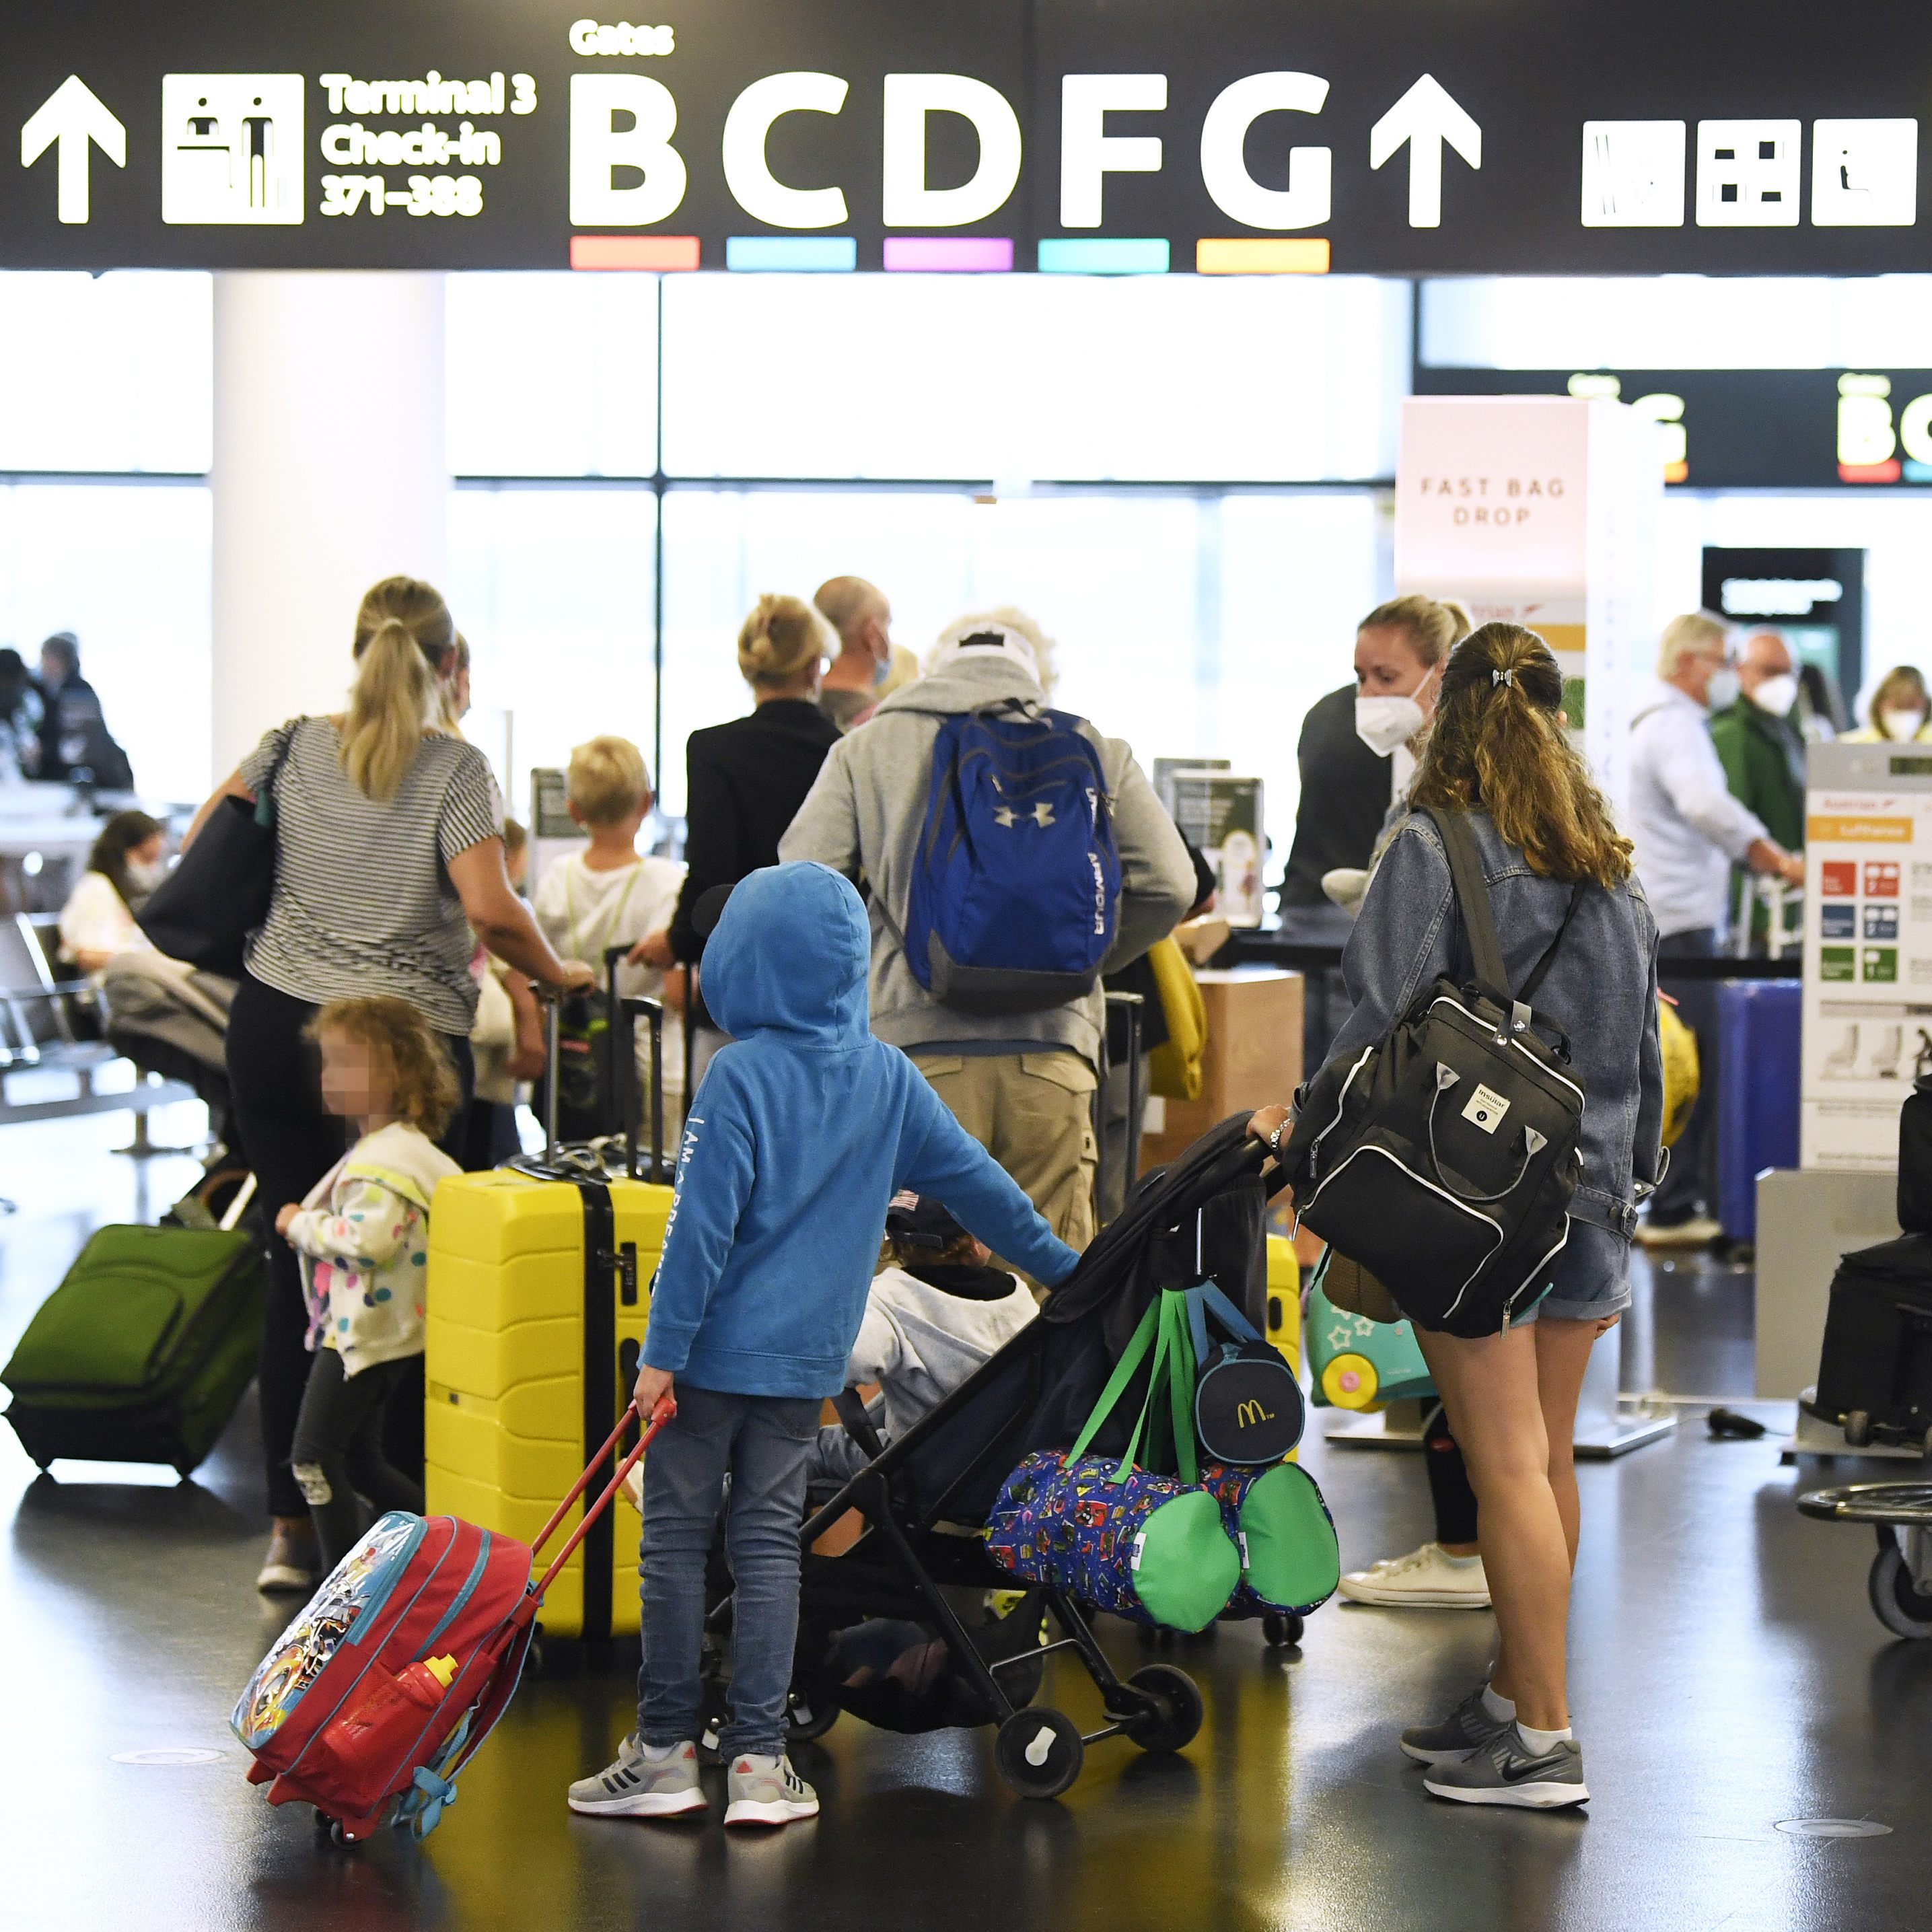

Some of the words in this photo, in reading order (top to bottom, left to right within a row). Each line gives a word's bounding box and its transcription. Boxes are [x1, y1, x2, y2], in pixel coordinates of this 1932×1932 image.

[569, 19, 675, 56] Gates
[320, 71, 505, 115] Terminal
[511, 73, 537, 114] 3
[320, 121, 501, 166] Check-in
[1420, 477, 1489, 497] FAST
[1506, 477, 1565, 498] BAG
[1453, 507, 1531, 526] DROP
[681, 1130, 699, 1164] AM
